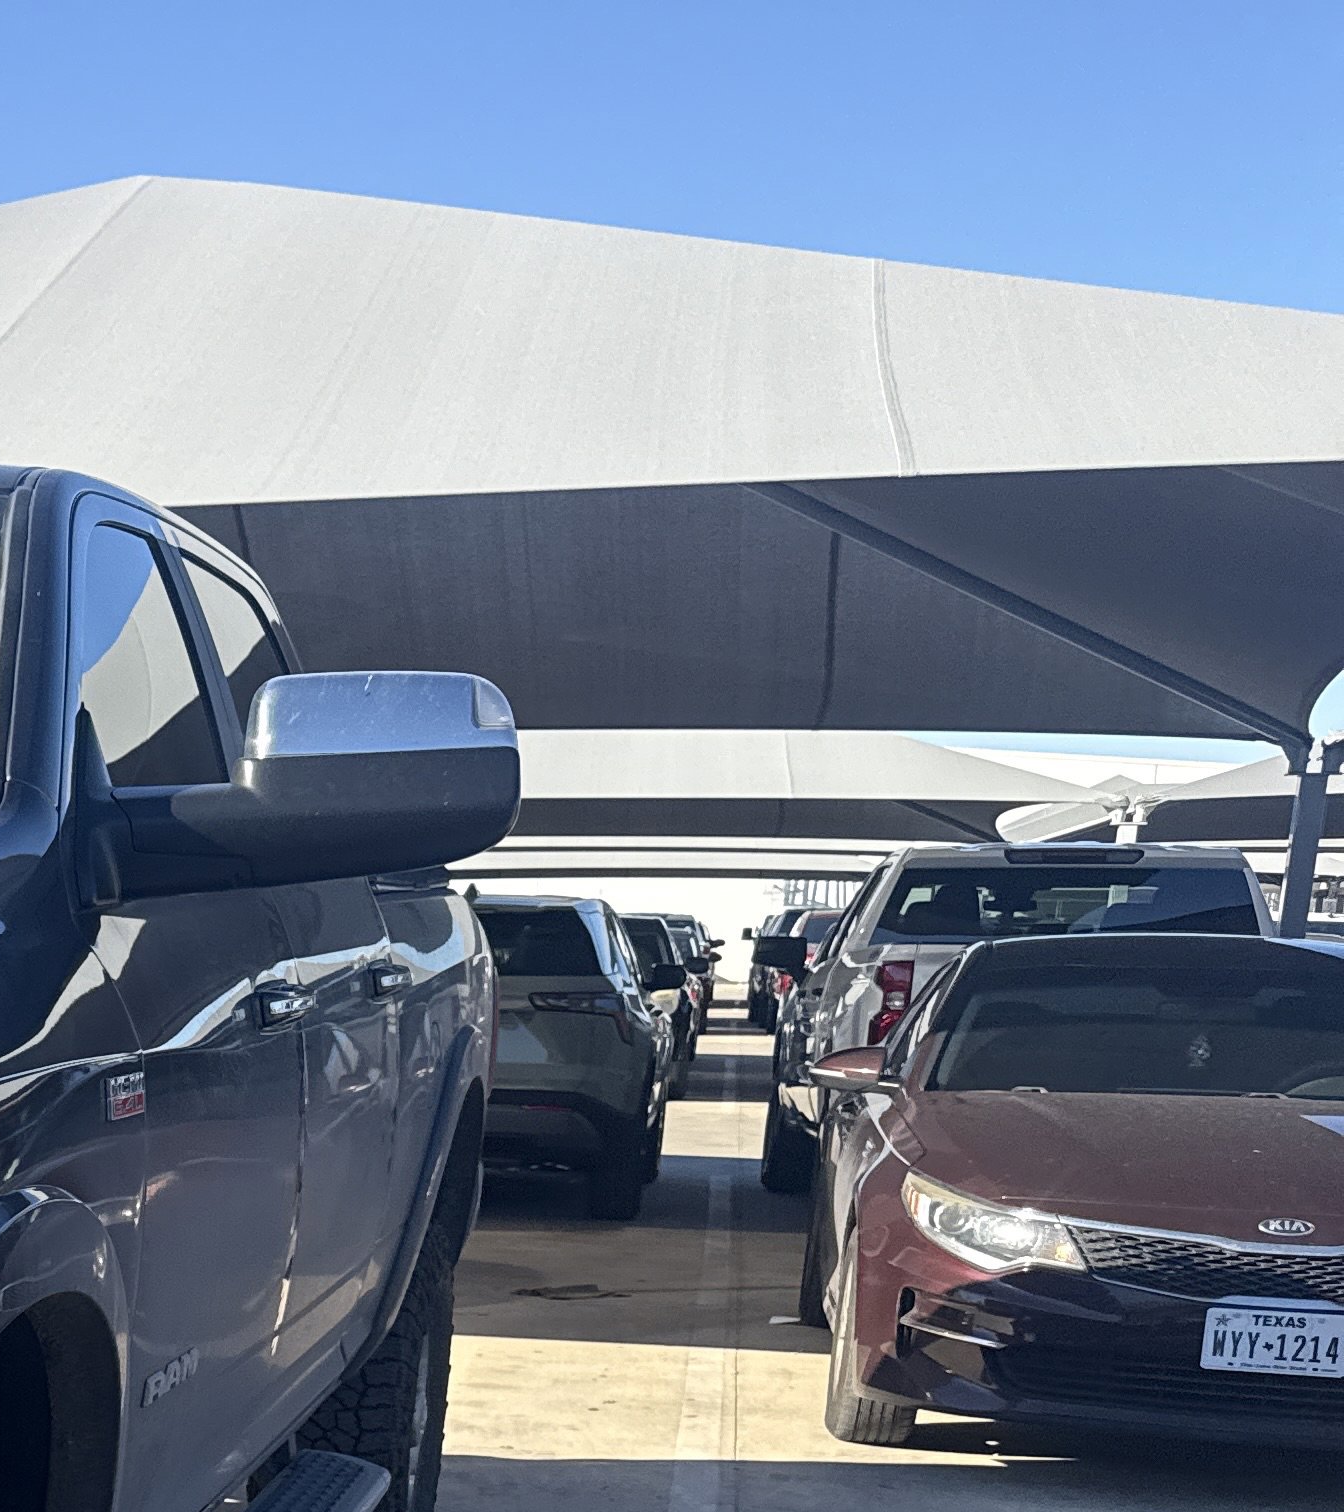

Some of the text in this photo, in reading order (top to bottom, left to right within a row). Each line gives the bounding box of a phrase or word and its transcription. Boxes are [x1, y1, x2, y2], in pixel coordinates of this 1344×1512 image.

[1268, 1219, 1306, 1232] KIA
[1252, 1314, 1307, 1329] TEXAS
[140, 1346, 200, 1409] RAM
